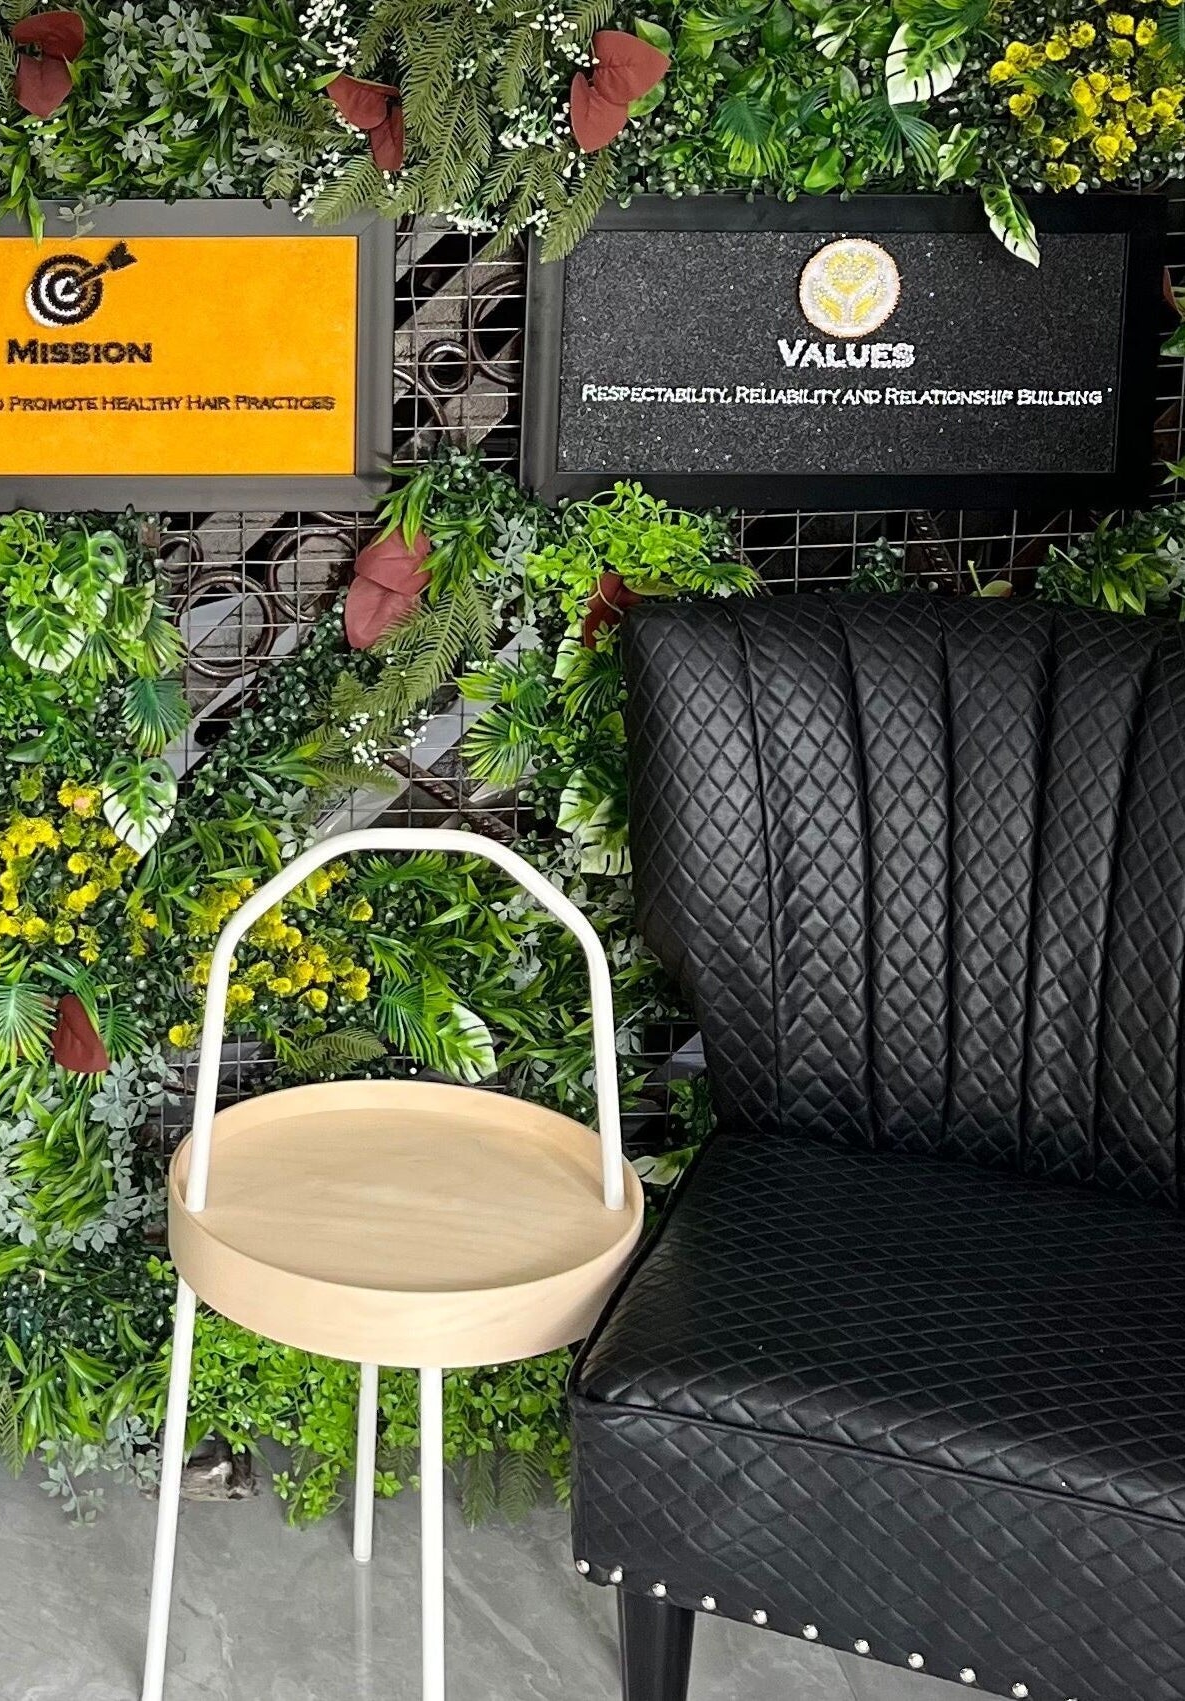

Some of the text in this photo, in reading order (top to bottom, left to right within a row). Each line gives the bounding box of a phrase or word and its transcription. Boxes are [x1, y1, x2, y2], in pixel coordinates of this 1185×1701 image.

[7, 338, 152, 364] MISSION
[777, 338, 915, 368] VALUES
[9, 395, 98, 412] PROMOTE
[102, 396, 183, 411] HEALTHY
[187, 395, 231, 411] HAIR
[236, 395, 336, 411] PRACTICES
[582, 384, 1102, 406] RESPECTABILITY, RELIABILITY AND RELATIONSHIP BUILDING
